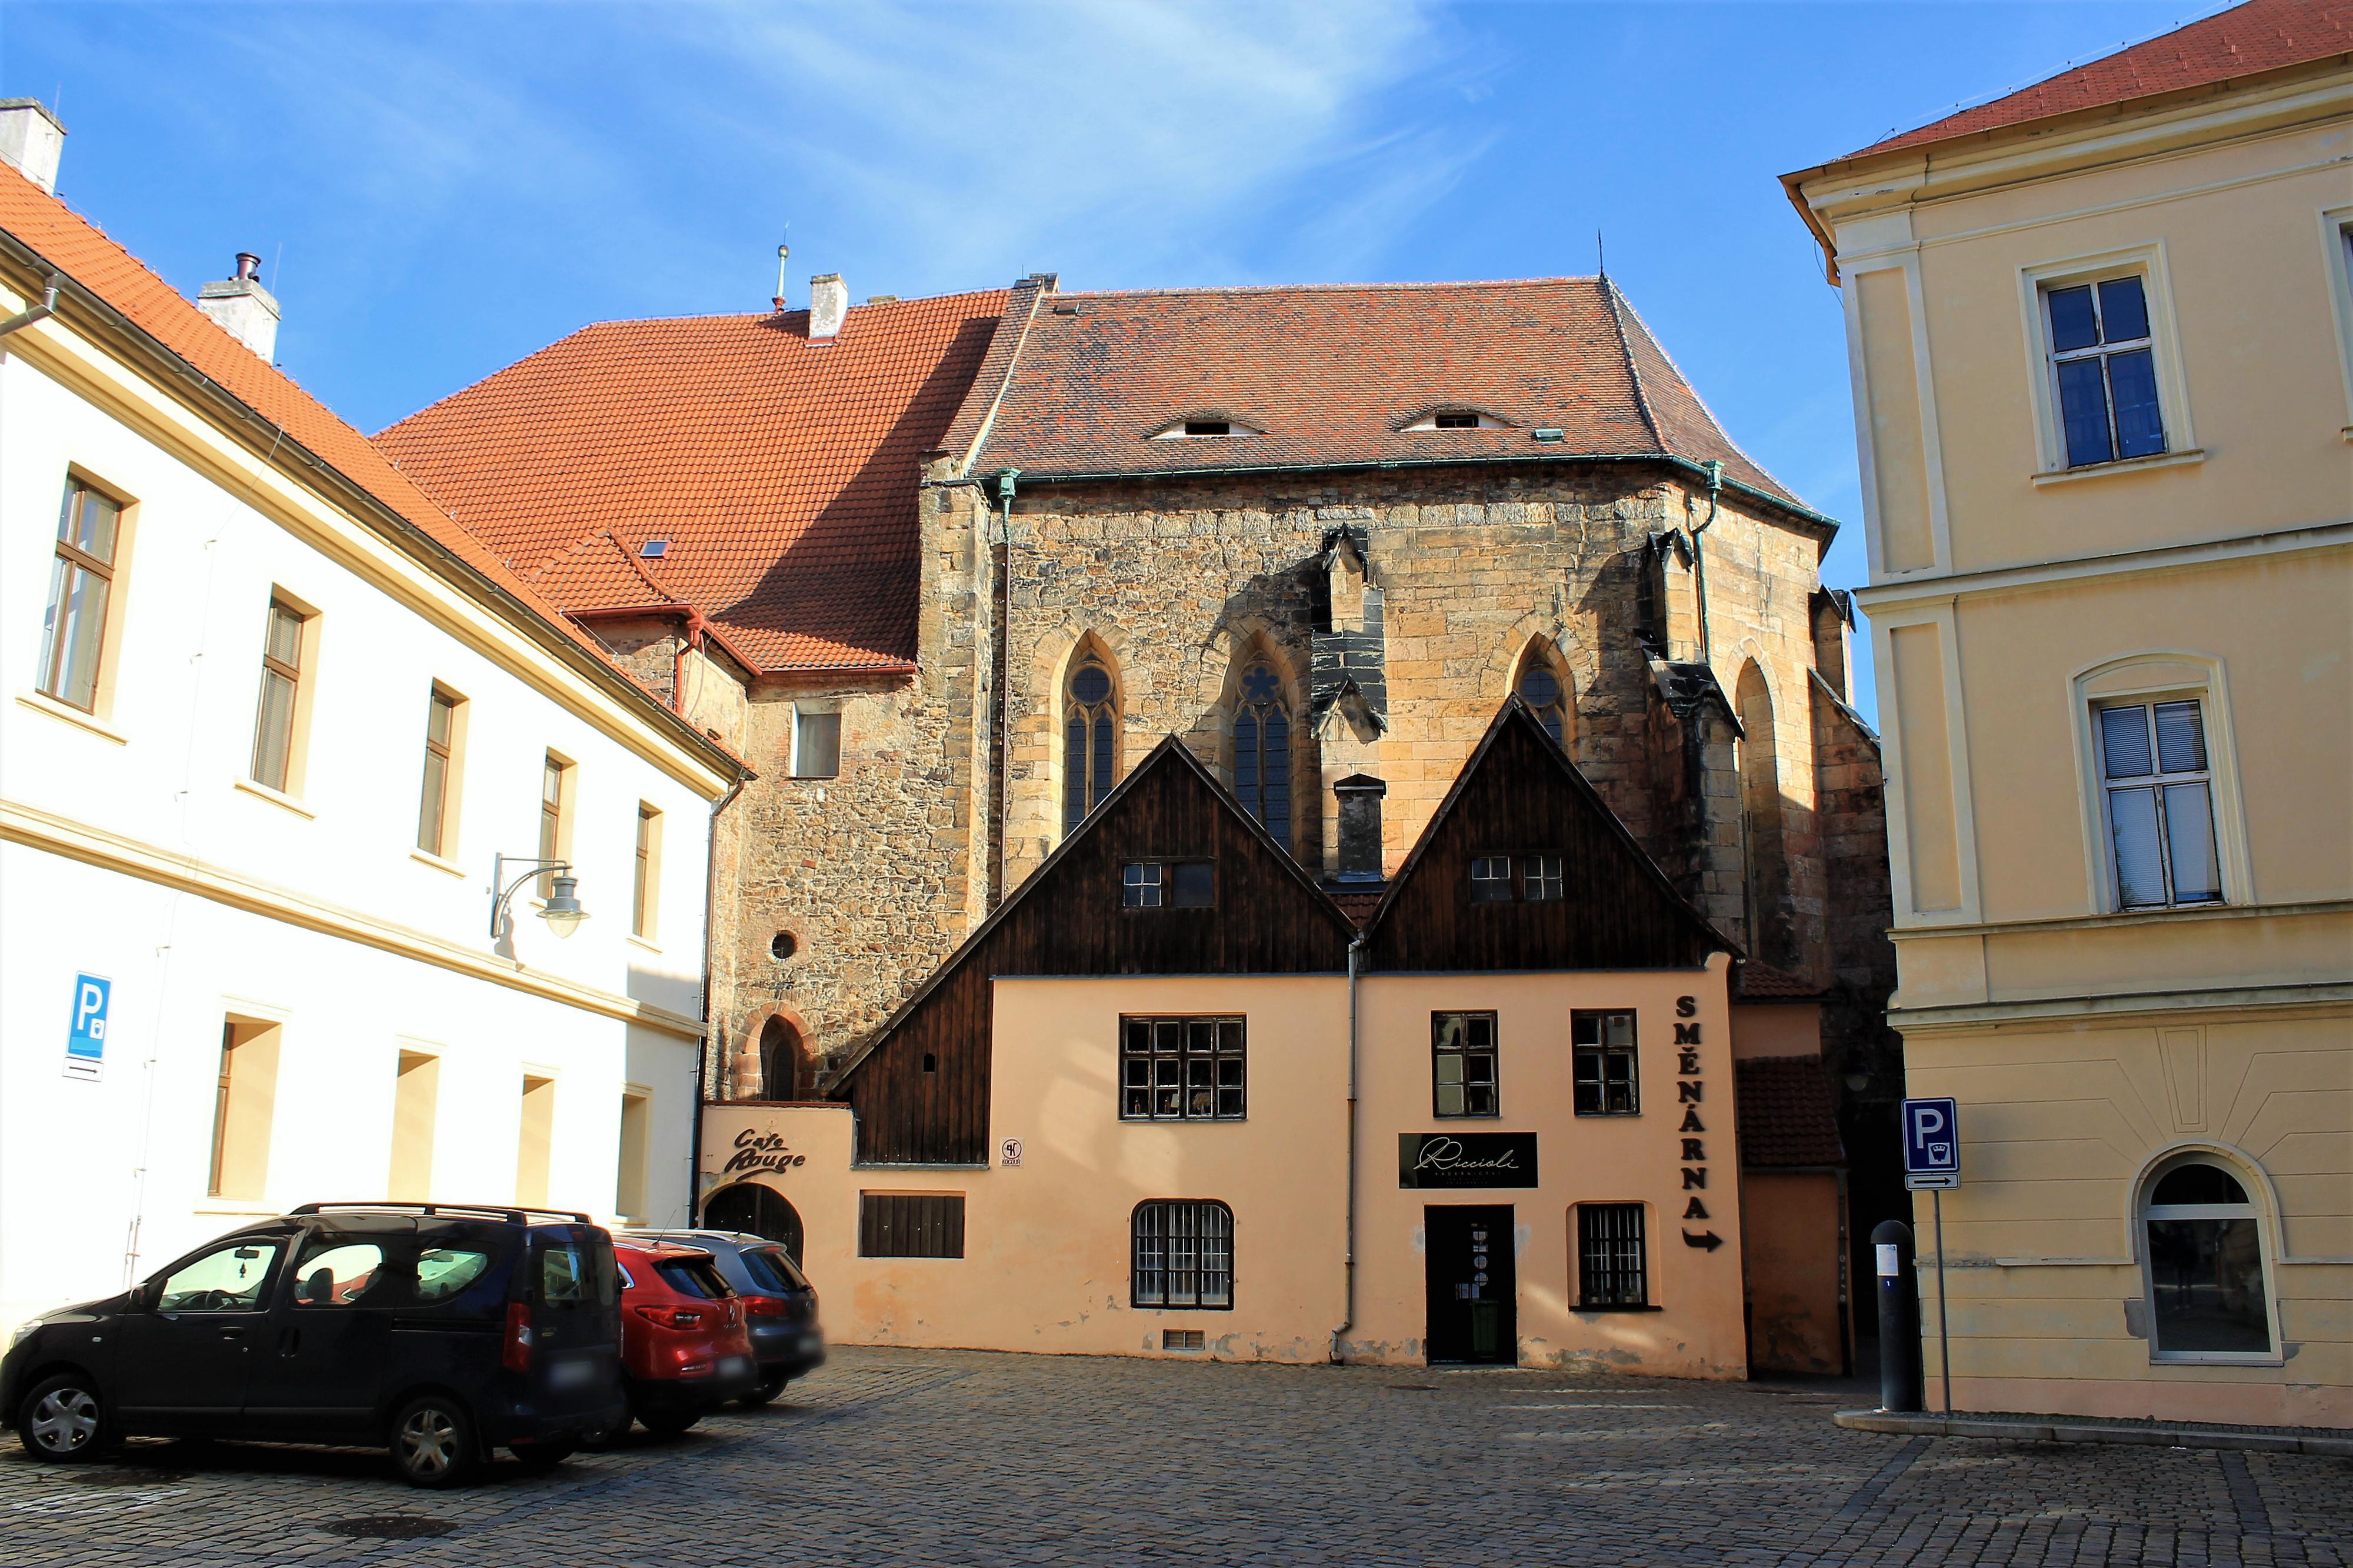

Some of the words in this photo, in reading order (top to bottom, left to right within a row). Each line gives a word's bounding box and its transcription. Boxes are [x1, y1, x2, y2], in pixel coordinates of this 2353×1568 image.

[77, 983, 103, 1030] P
[1674, 995, 1709, 1219] SMĚNÁRNA
[735, 1129, 788, 1151] Cafe
[1915, 1109, 1944, 1149] P
[724, 1148, 806, 1182] Rouge
[1413, 1137, 1519, 1170] Riccioli
